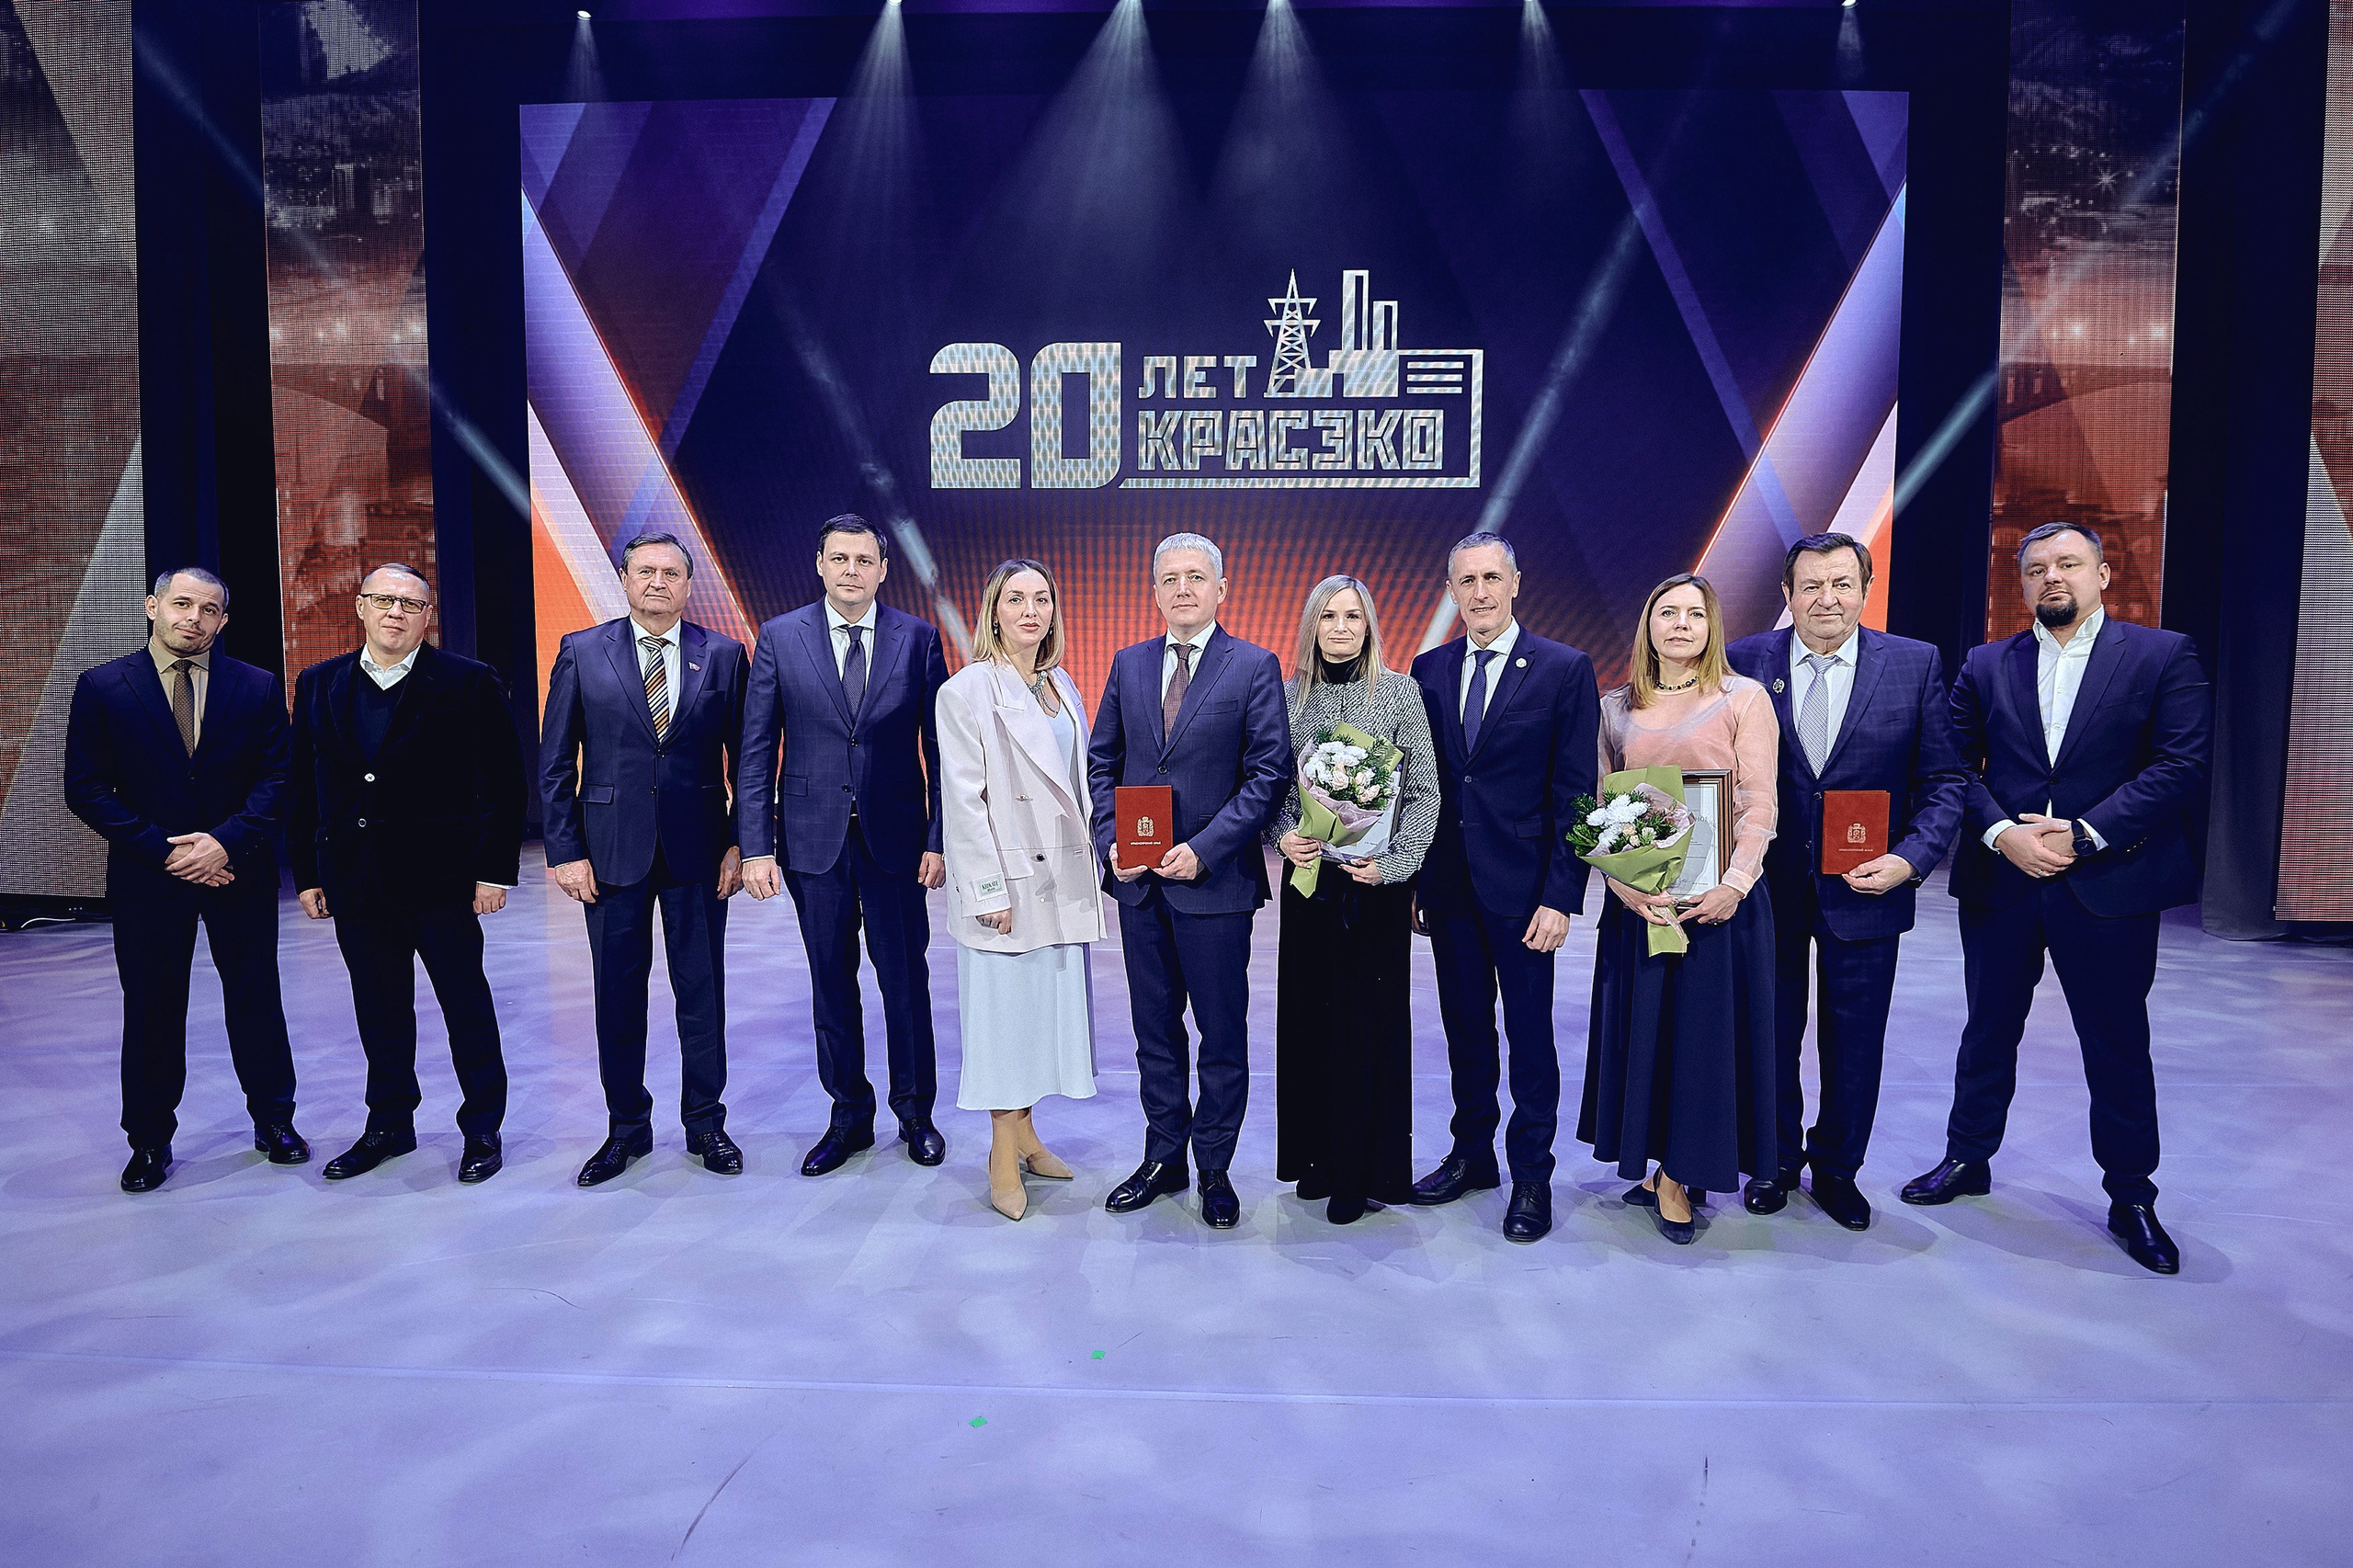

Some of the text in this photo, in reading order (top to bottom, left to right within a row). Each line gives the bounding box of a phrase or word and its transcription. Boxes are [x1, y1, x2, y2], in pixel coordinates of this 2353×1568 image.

[929, 342, 1257, 489] 20 ЛЕТ
[1137, 409, 1444, 471] КРАСЭКО
